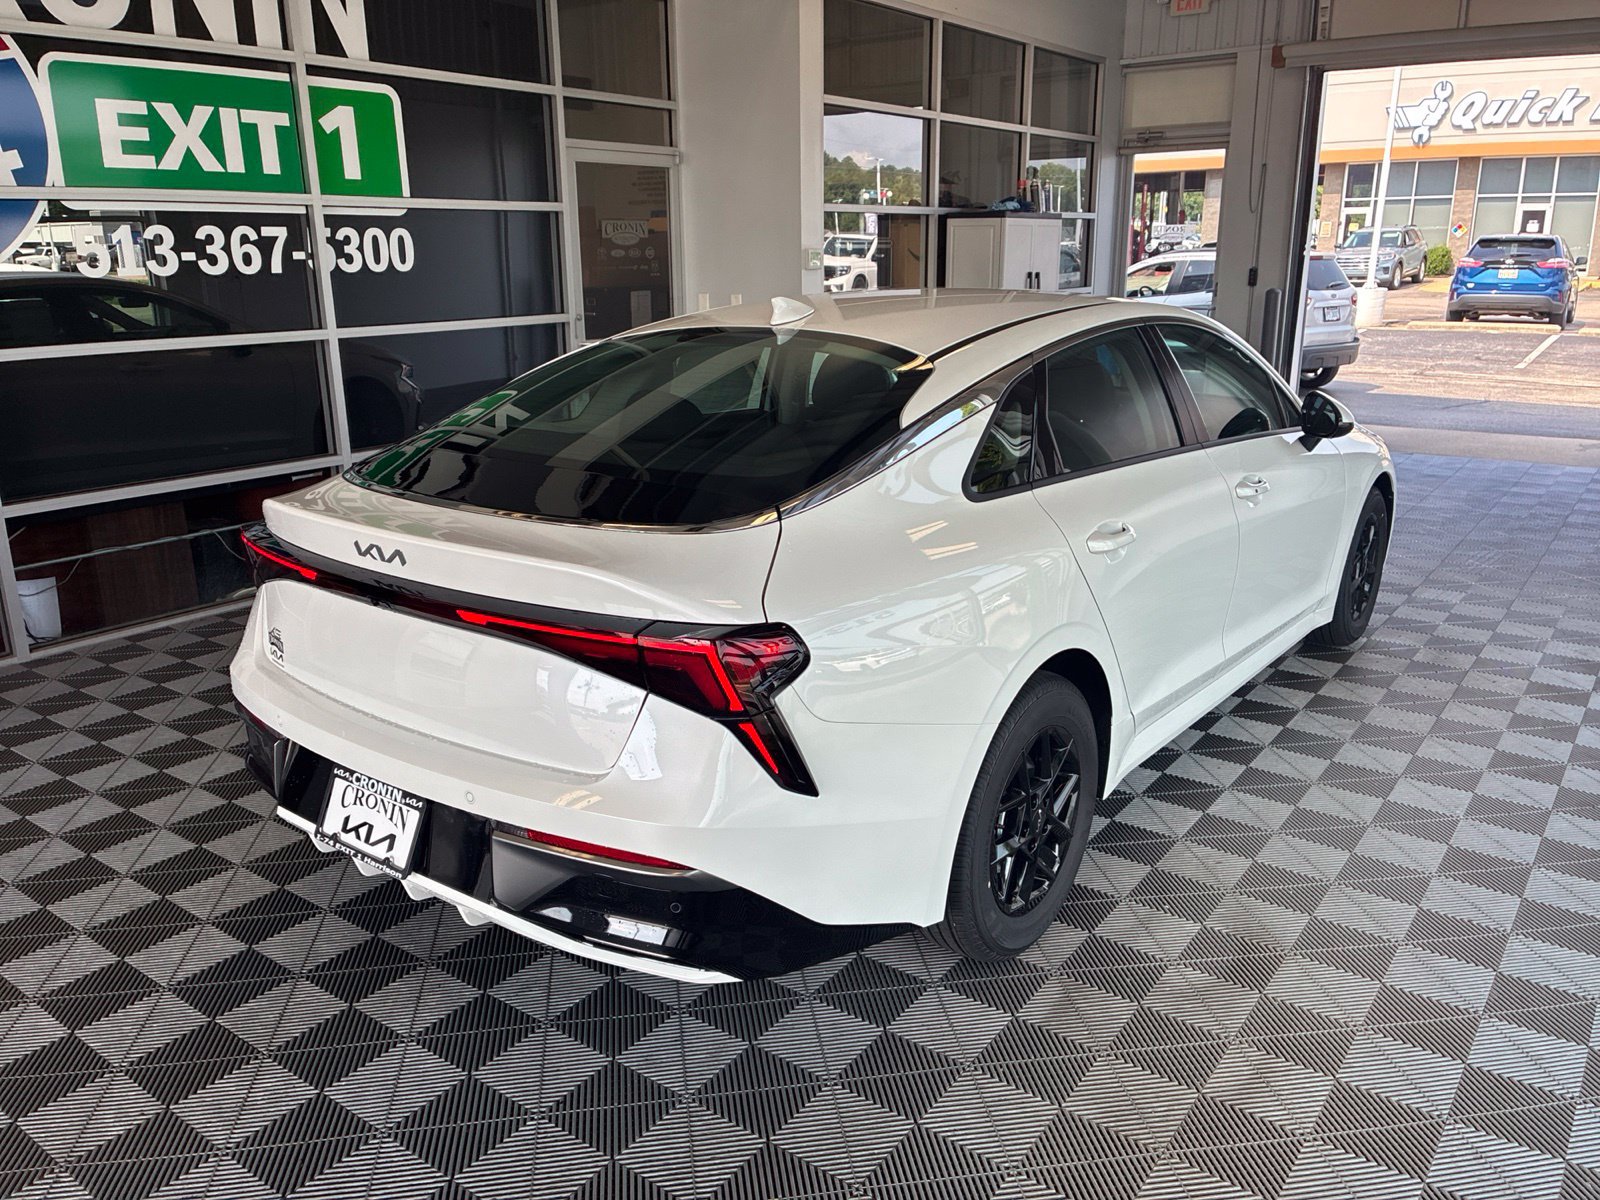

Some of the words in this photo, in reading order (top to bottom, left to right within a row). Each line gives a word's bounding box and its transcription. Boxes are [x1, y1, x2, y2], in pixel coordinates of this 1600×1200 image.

[1451, 88, 1590, 133] Quick
[94, 97, 291, 176] EXIT
[317, 105, 362, 180] 1
[76, 223, 415, 278] 513-367-5300
[353, 539, 407, 567] KIA
[352, 772, 402, 803] CRONIN
[341, 784, 410, 835] CRONIN
[341, 814, 397, 854] KIA
[335, 844, 356, 856] EXIT
[363, 856, 402, 879] Harrison
